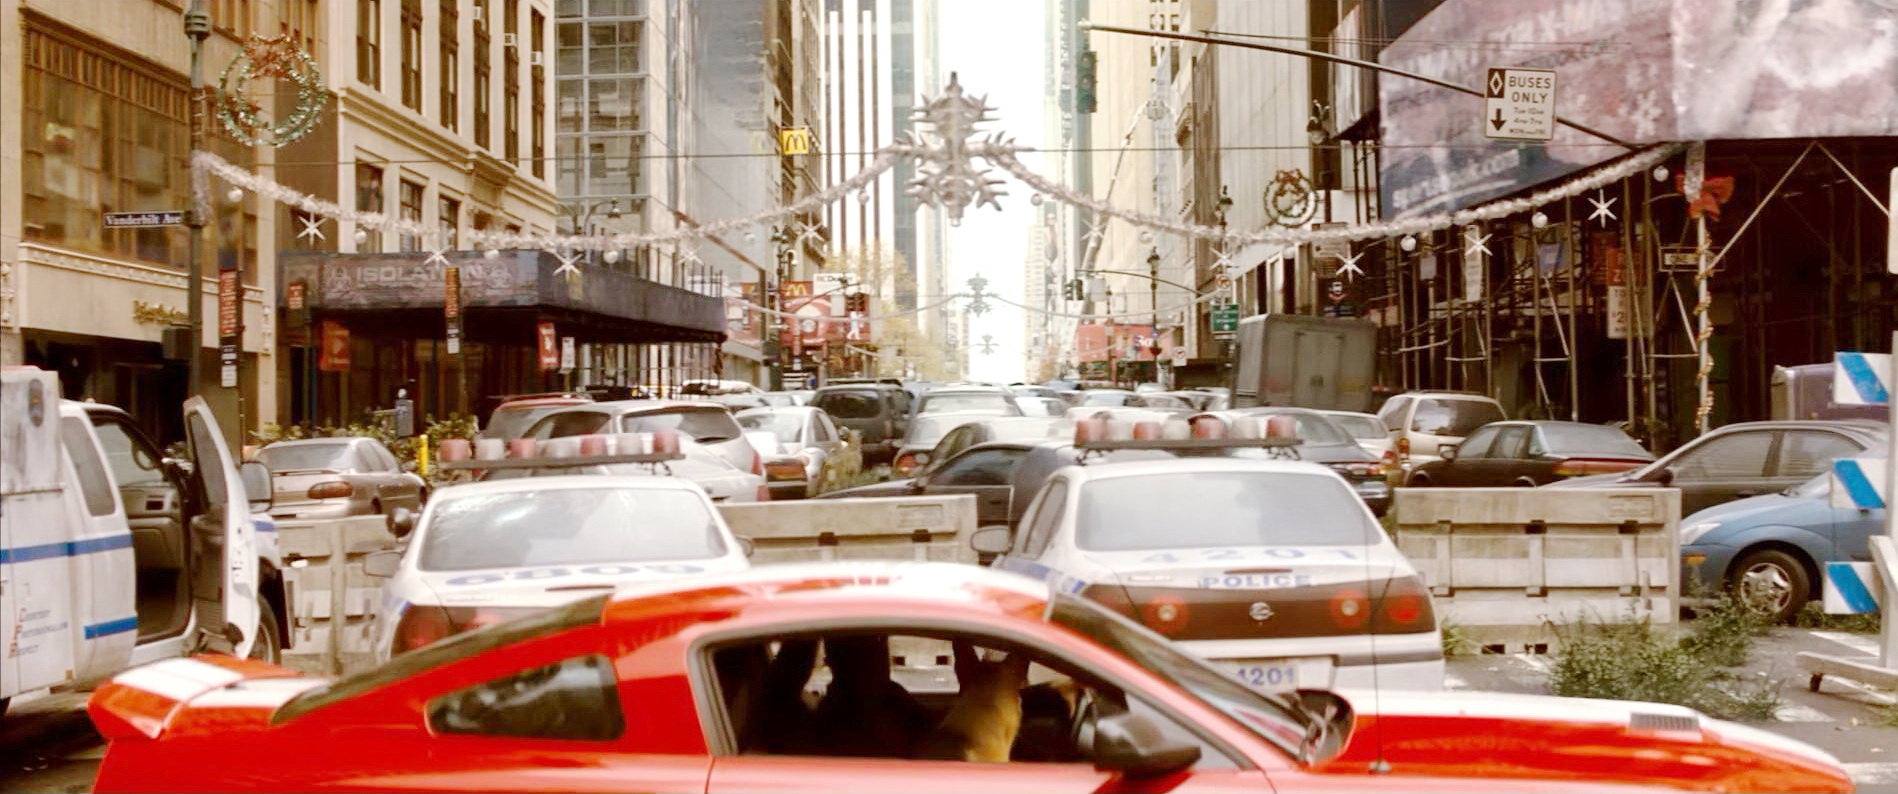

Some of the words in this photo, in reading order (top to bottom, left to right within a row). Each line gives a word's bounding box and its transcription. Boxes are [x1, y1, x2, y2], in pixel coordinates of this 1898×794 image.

[1508, 76, 1551, 89] BUSES
[1511, 91, 1548, 104] ONLY
[1201, 574, 1312, 589] POLICE
